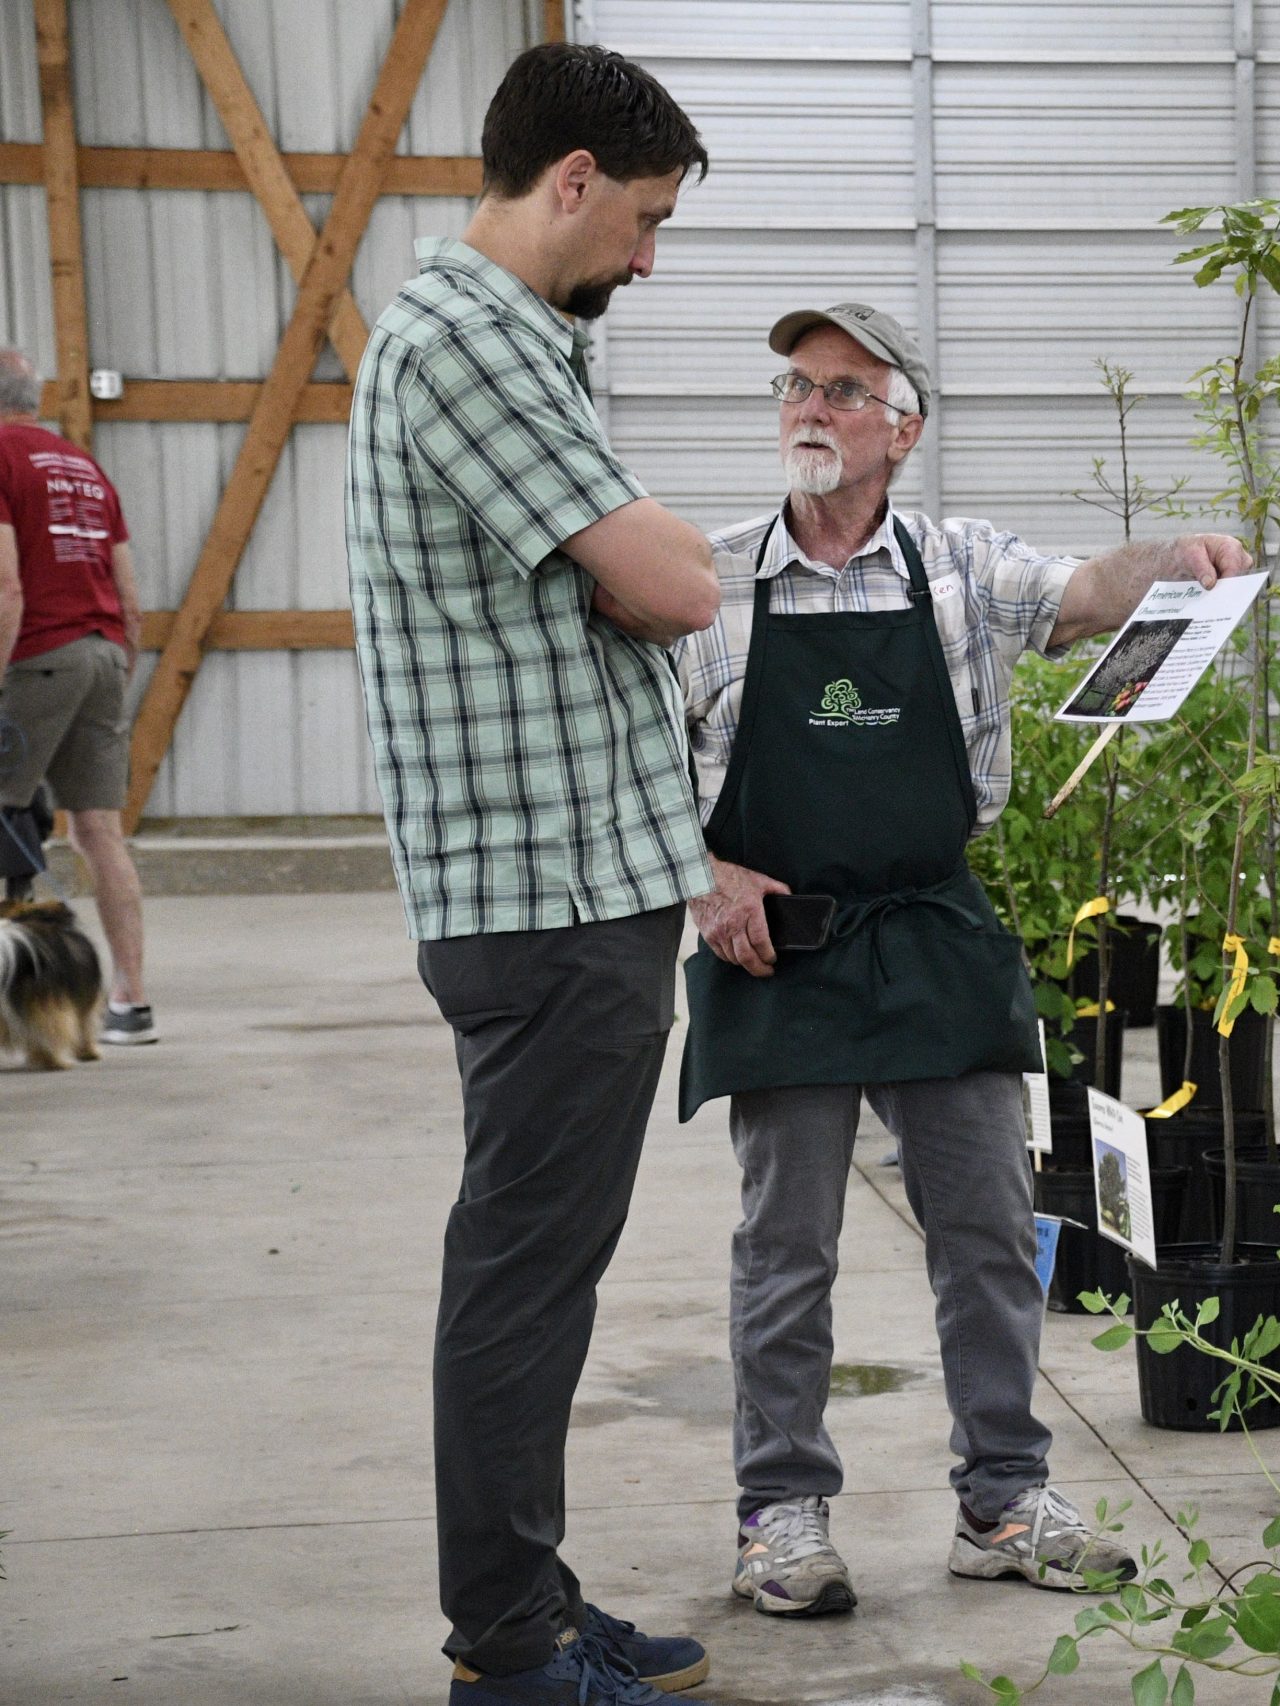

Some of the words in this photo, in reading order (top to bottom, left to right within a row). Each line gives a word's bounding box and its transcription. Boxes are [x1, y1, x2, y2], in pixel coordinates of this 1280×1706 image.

[1149, 587, 1183, 600] American
[1182, 586, 1204, 600] Plum
[867, 707, 901, 715] Conservancy
[879, 713, 900, 721] County
[809, 718, 825, 726] Plant
[827, 719, 849, 727] Expert
